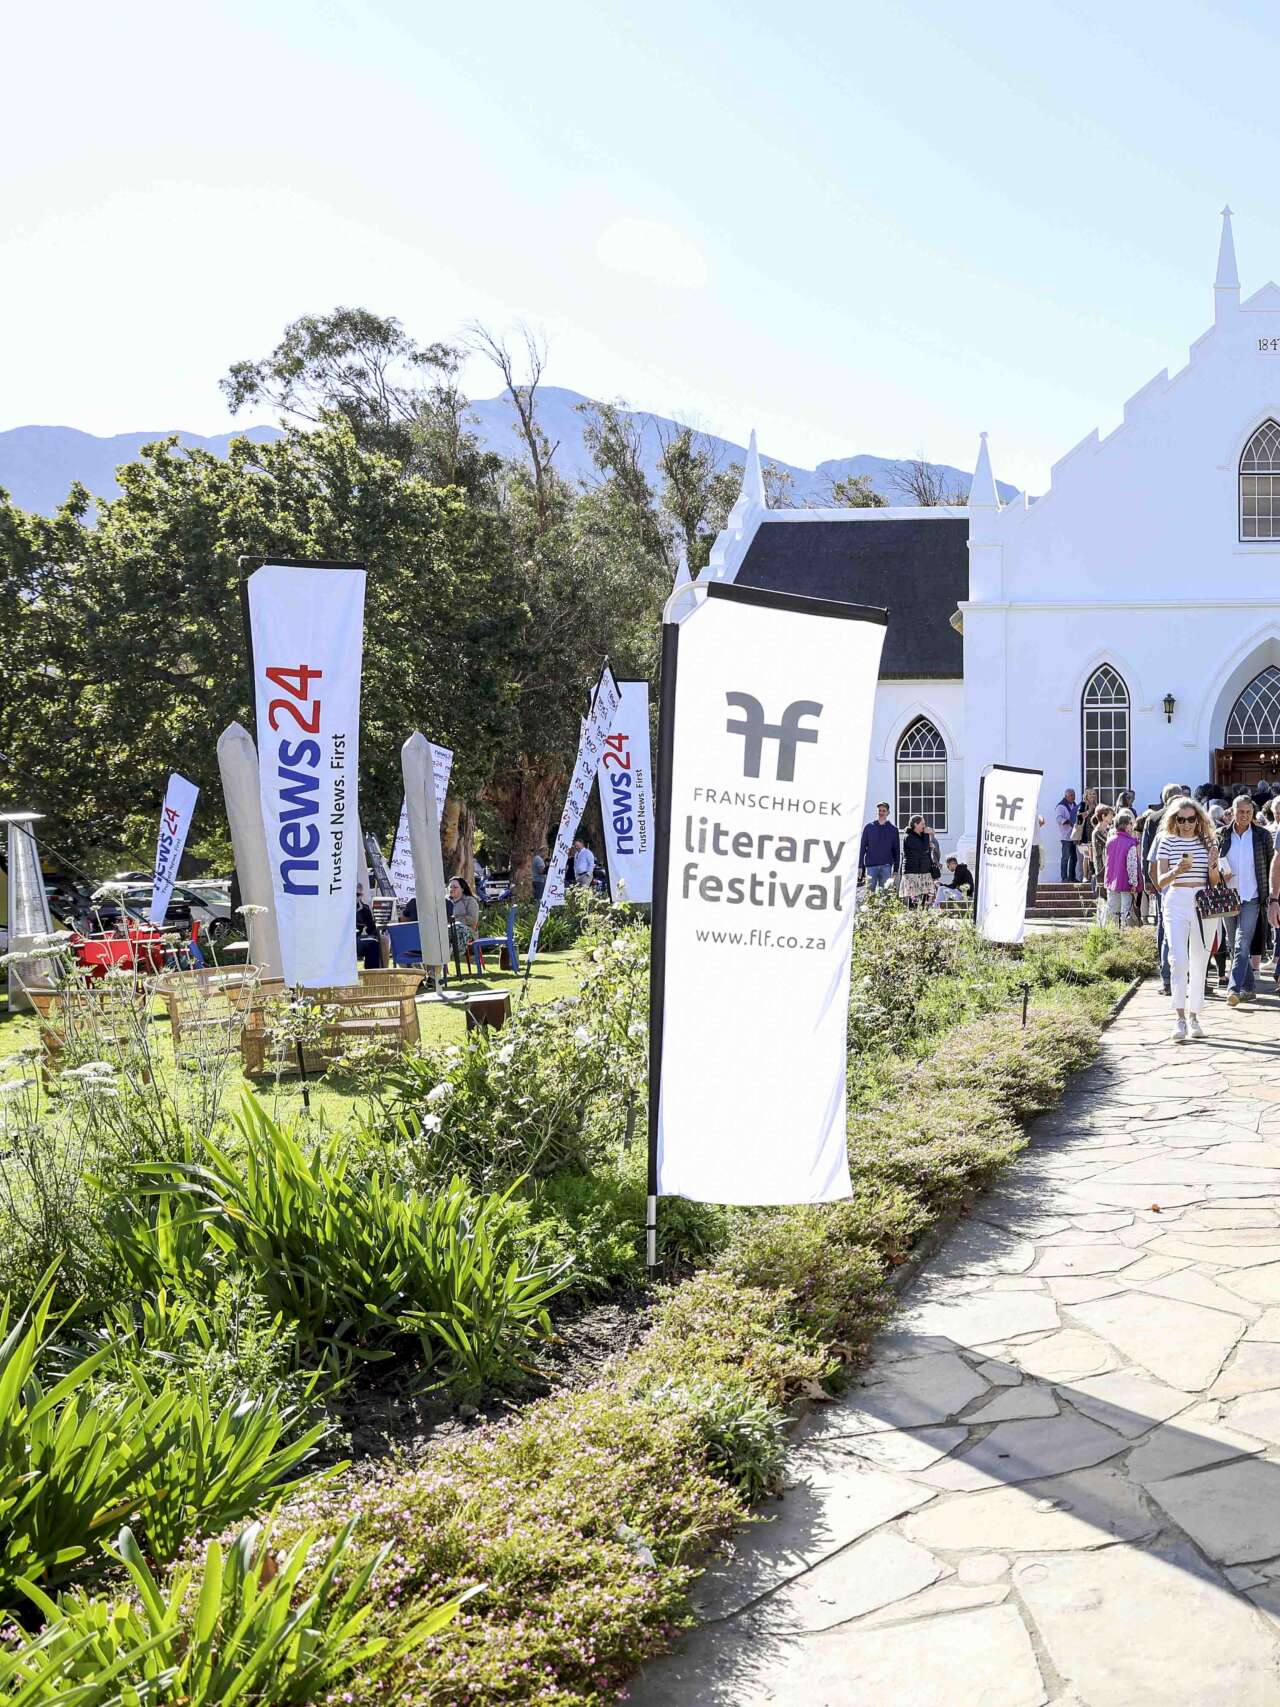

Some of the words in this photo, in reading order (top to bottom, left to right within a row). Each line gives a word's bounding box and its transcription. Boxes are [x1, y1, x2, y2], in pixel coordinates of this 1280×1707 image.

[330, 733, 346, 769] First
[266, 665, 323, 896] news24
[602, 733, 634, 854] news24
[636, 769, 644, 788] First
[330, 775, 345, 826] News.
[694, 788, 842, 816] FRANSCHHOEK
[639, 821, 647, 855] Trusted
[685, 815, 846, 873] literary
[983, 843, 1027, 859] festival
[984, 829, 1028, 848] literary
[330, 831, 344, 895] Trusted
[682, 862, 843, 911] festival
[695, 929, 827, 950] www.flf.co.za
